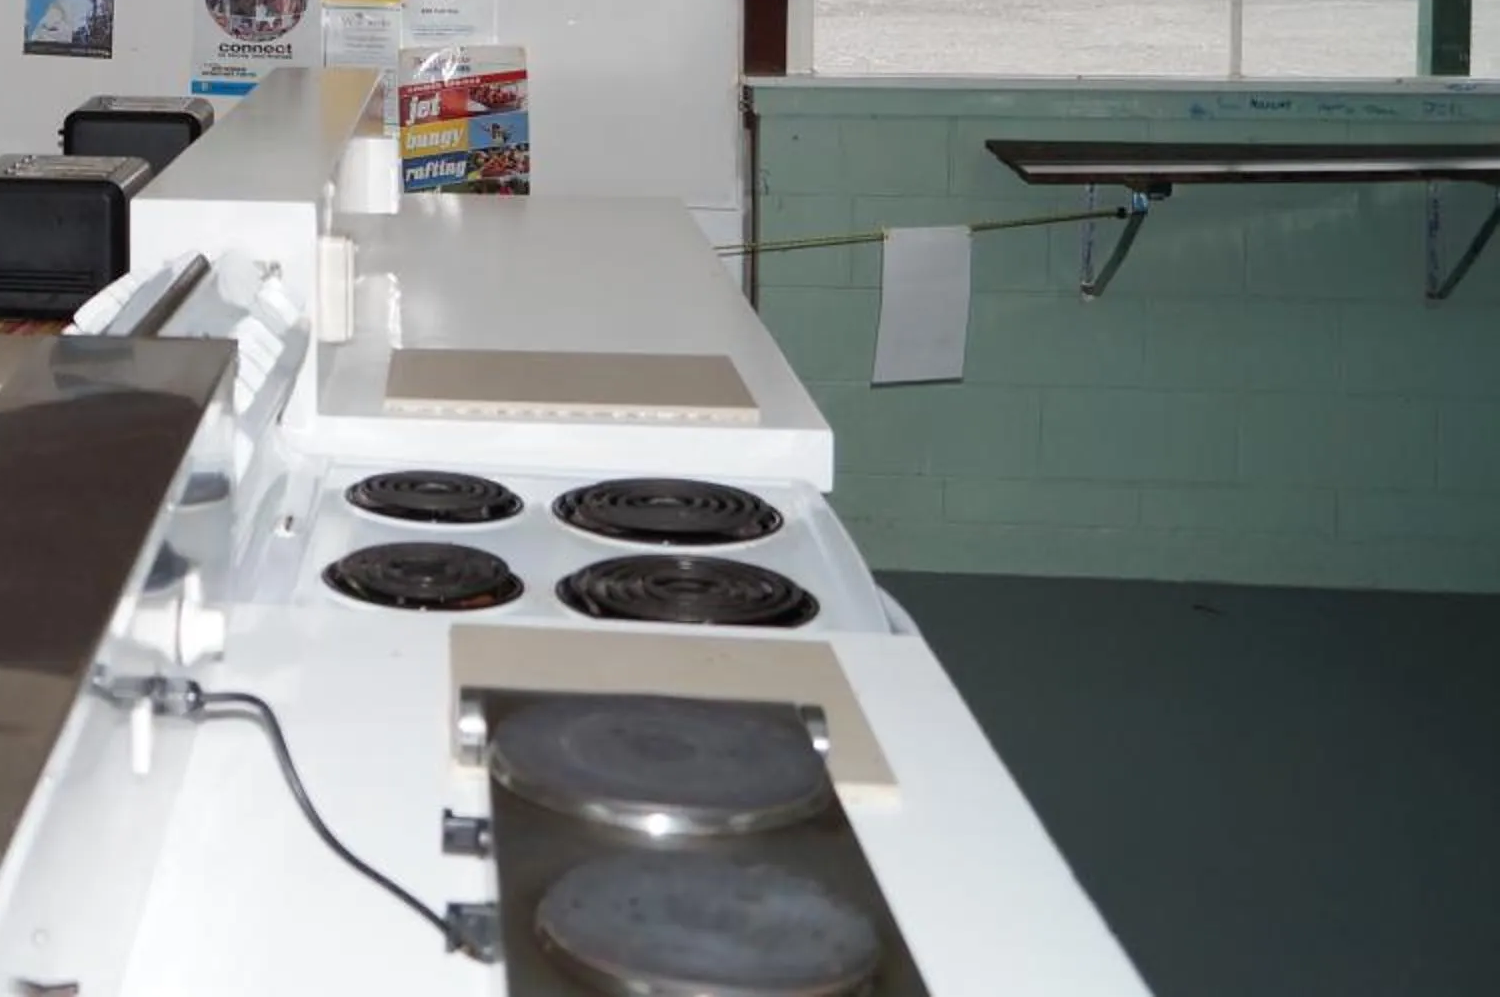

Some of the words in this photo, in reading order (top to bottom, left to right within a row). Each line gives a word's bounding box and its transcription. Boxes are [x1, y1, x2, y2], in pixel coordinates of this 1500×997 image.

[218, 42, 293, 55] connect
[405, 92, 443, 127] jet
[406, 128, 465, 152] bungy
[405, 159, 468, 183] rafting
